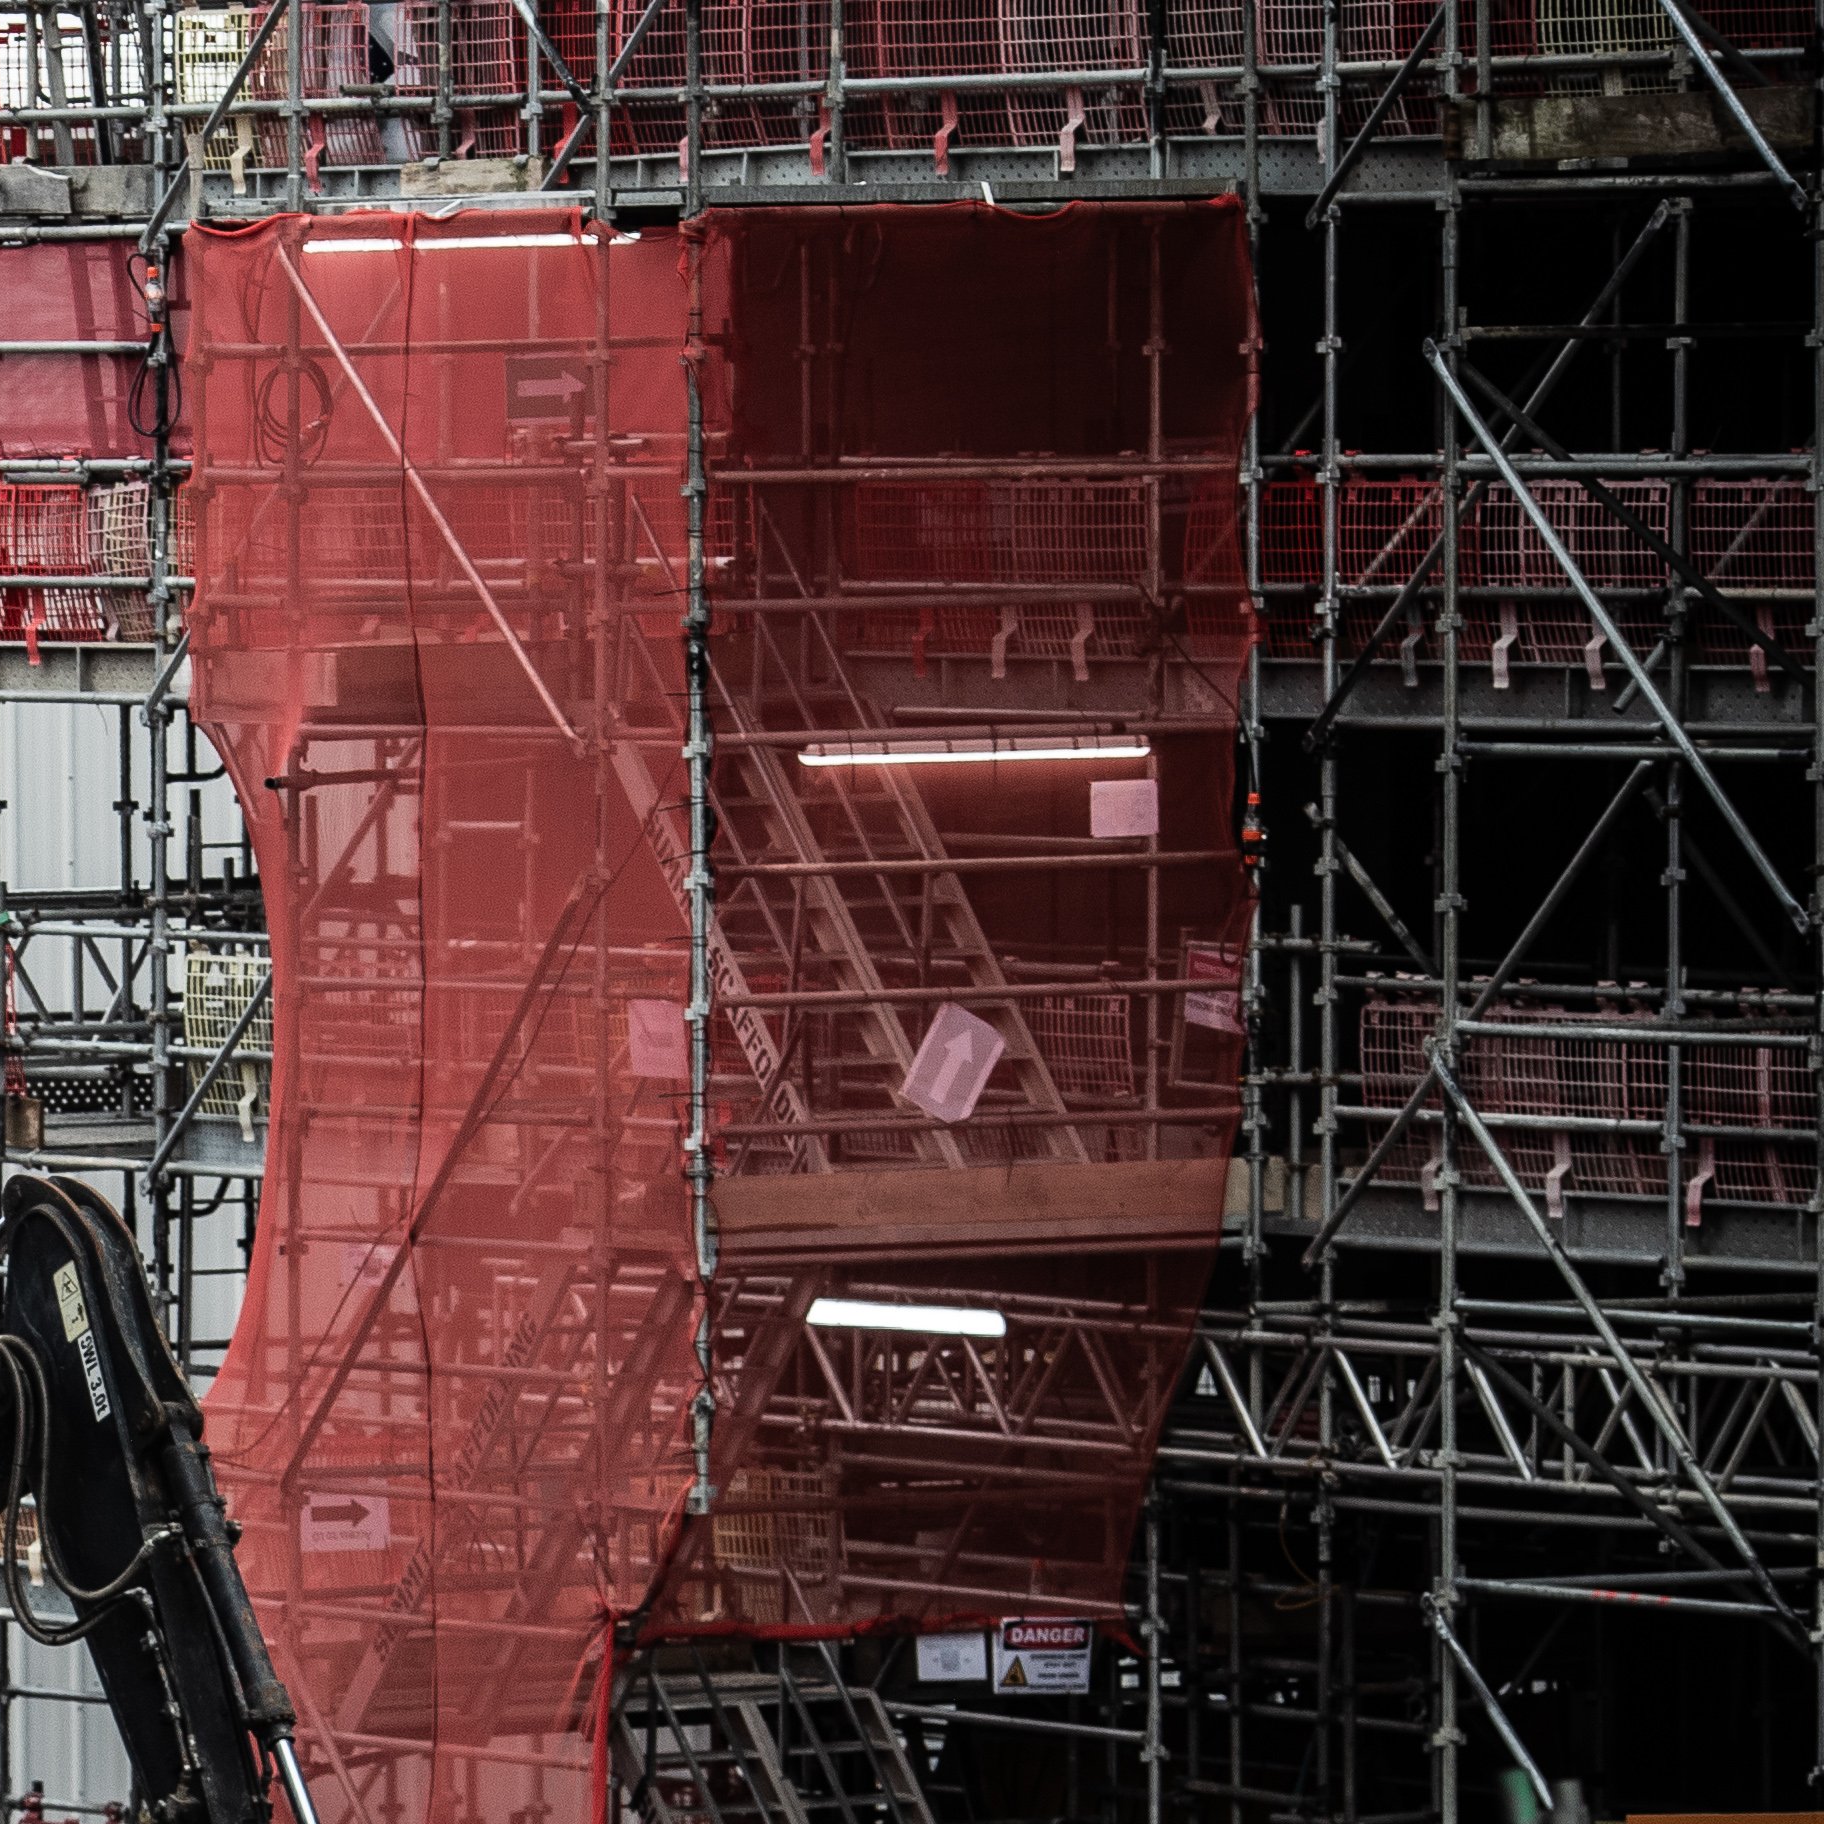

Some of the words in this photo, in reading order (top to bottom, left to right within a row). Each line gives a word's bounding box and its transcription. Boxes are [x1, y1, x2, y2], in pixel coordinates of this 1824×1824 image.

[80, 1335, 98, 1376] SWL
[90, 1377, 108, 1416] 3.0t
[1010, 1627, 1085, 1644] DANGER
